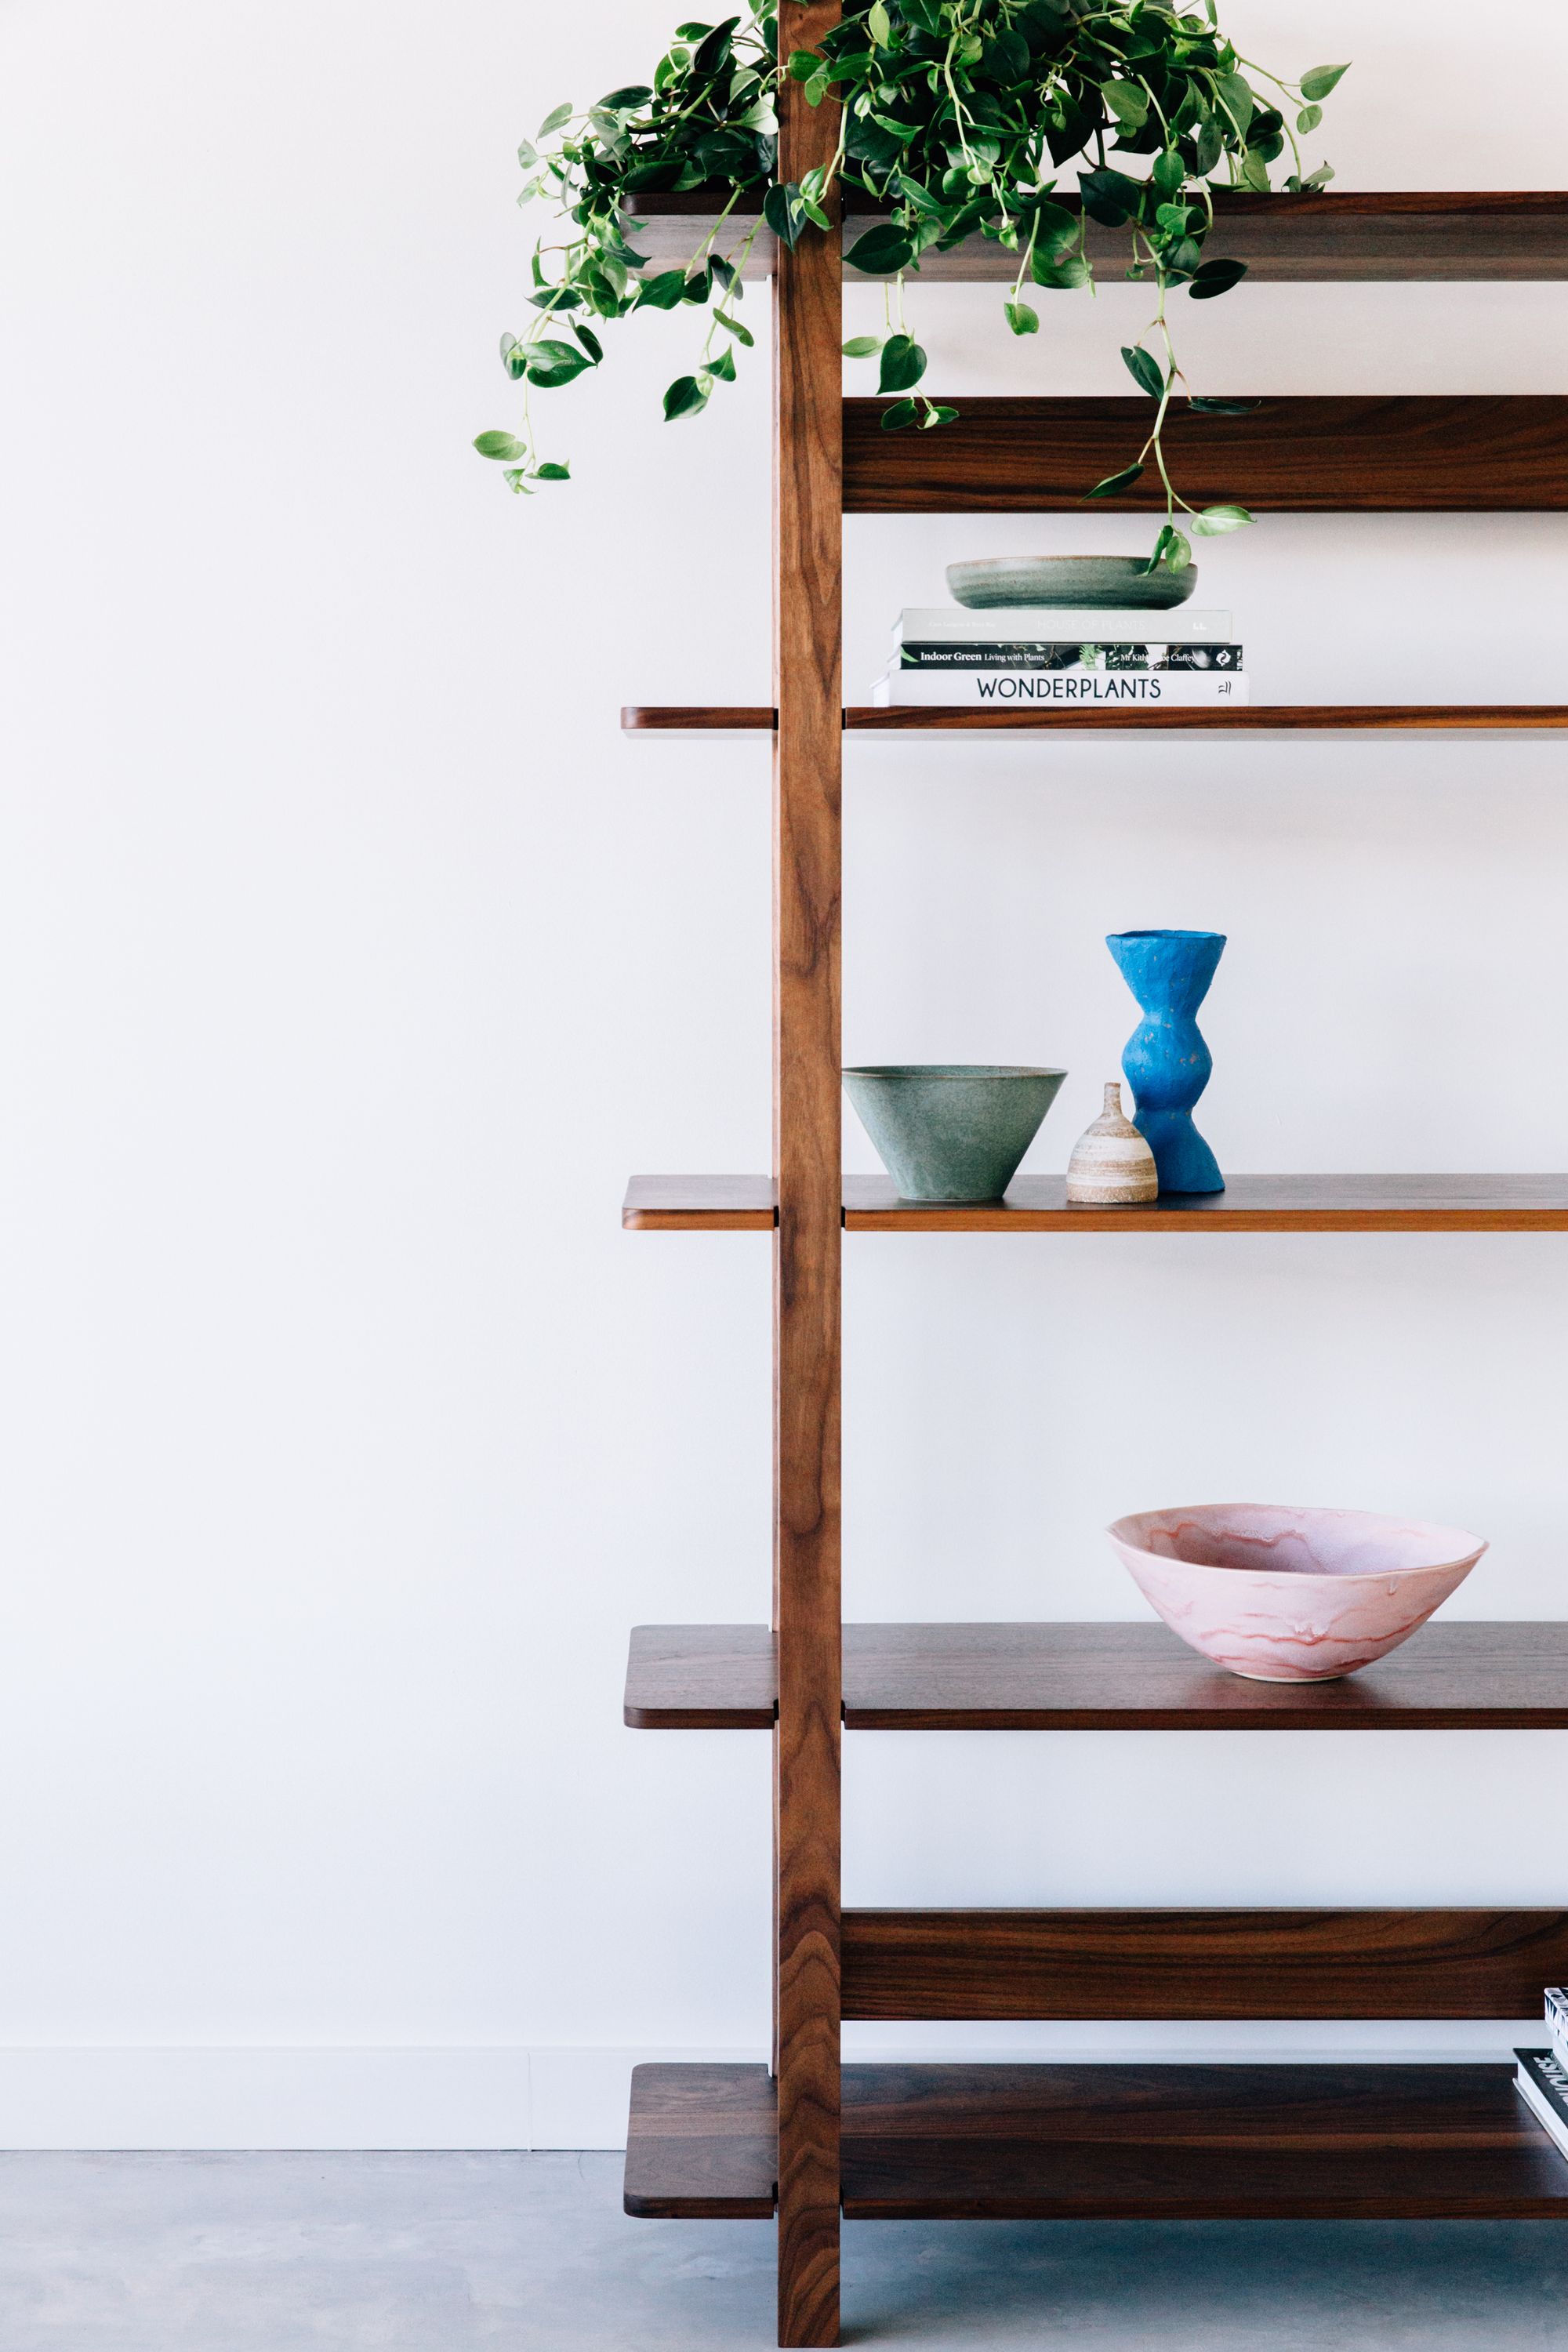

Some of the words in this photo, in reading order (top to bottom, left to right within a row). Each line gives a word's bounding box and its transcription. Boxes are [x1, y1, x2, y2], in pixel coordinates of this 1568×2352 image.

[1036, 620, 1079, 630] HOUSE
[1082, 620, 1098, 630] OF
[1102, 620, 1146, 630] PLANTS
[920, 652, 953, 661] Indoor
[953, 652, 982, 661] Green
[984, 653, 1006, 662] Living
[976, 677, 1162, 699] WONDERPLANTS
